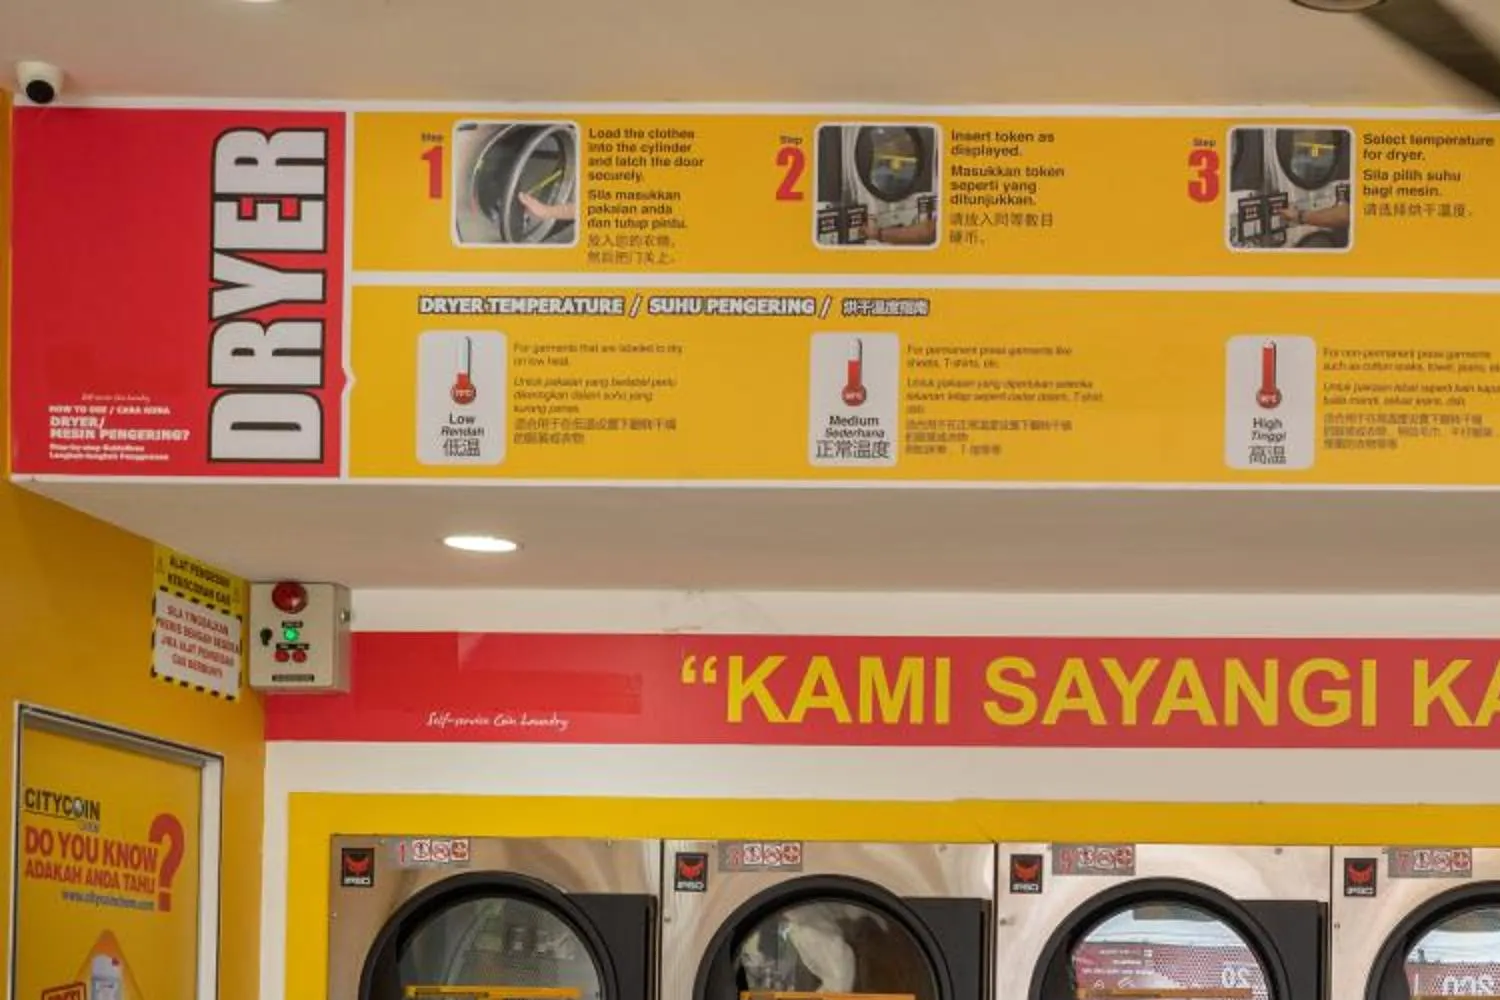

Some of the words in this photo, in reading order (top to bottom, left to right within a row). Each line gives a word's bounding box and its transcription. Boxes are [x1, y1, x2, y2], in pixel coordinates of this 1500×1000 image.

[588, 128, 620, 139] Load
[625, 128, 644, 139] the
[649, 128, 695, 139] clothes
[952, 129, 991, 142] Insert
[996, 129, 1034, 142] token
[1039, 129, 1055, 142] as
[1363, 133, 1405, 147] Select
[1410, 133, 1495, 147] temperature
[588, 141, 612, 154] into
[617, 141, 636, 154] the
[641, 141, 692, 154] cylinder
[951, 145, 1022, 157] displayed.
[588, 156, 611, 168] and
[616, 156, 646, 168] latch
[651, 156, 670, 168] the
[675, 156, 704, 168] door
[1363, 149, 1381, 162] for
[1386, 149, 1426, 162] dryer.
[421, 146, 444, 200] 1
[588, 170, 643, 182] securely.
[775, 147, 805, 200] 2
[952, 165, 1021, 177] Masukkan
[1026, 165, 1064, 177] token
[1188, 150, 1220, 203] 3
[1363, 169, 1388, 183] Sila
[1393, 169, 1422, 183] pilih
[1427, 169, 1461, 183] suhu
[951, 180, 998, 193] seperti
[1003, 180, 1037, 193] yang
[1363, 185, 1392, 198] bagi
[1397, 185, 1442, 198] mesin.
[588, 189, 611, 201] Sila
[615, 189, 681, 201] masukkan
[951, 194, 1037, 206] ditunjukkan.
[588, 203, 637, 216] pakaian
[642, 203, 672, 216] anda
[588, 217, 610, 230] dan
[615, 217, 647, 230] tutup
[652, 217, 687, 230] pintu.
[206, 127, 330, 463] DRYER
[419, 296, 488, 315] DRYER
[488, 296, 625, 316] TEMPERATURE
[648, 297, 702, 316] SUHU
[703, 297, 816, 317] PENGERING
[448, 413, 476, 426] Low
[828, 415, 880, 427] Medium
[1252, 417, 1284, 430] High
[49, 427, 96, 439] MESIN
[99, 428, 191, 441] PENGERING?
[440, 425, 485, 438] Rendah
[824, 427, 886, 439] Sederhana
[1250, 431, 1287, 443] Tinggi
[680, 654, 953, 725] “KAMI
[981, 654, 1378, 728] SAYANGI
[519, 712, 570, 732] Laundry
[24, 788, 100, 821] CITYCOIN
[24, 824, 53, 857] DO
[57, 831, 99, 865] YOU
[103, 839, 158, 874] KNOW
[24, 858, 82, 884] ADAKAH
[85, 867, 121, 890] ANDA
[122, 872, 156, 895] TAHU
